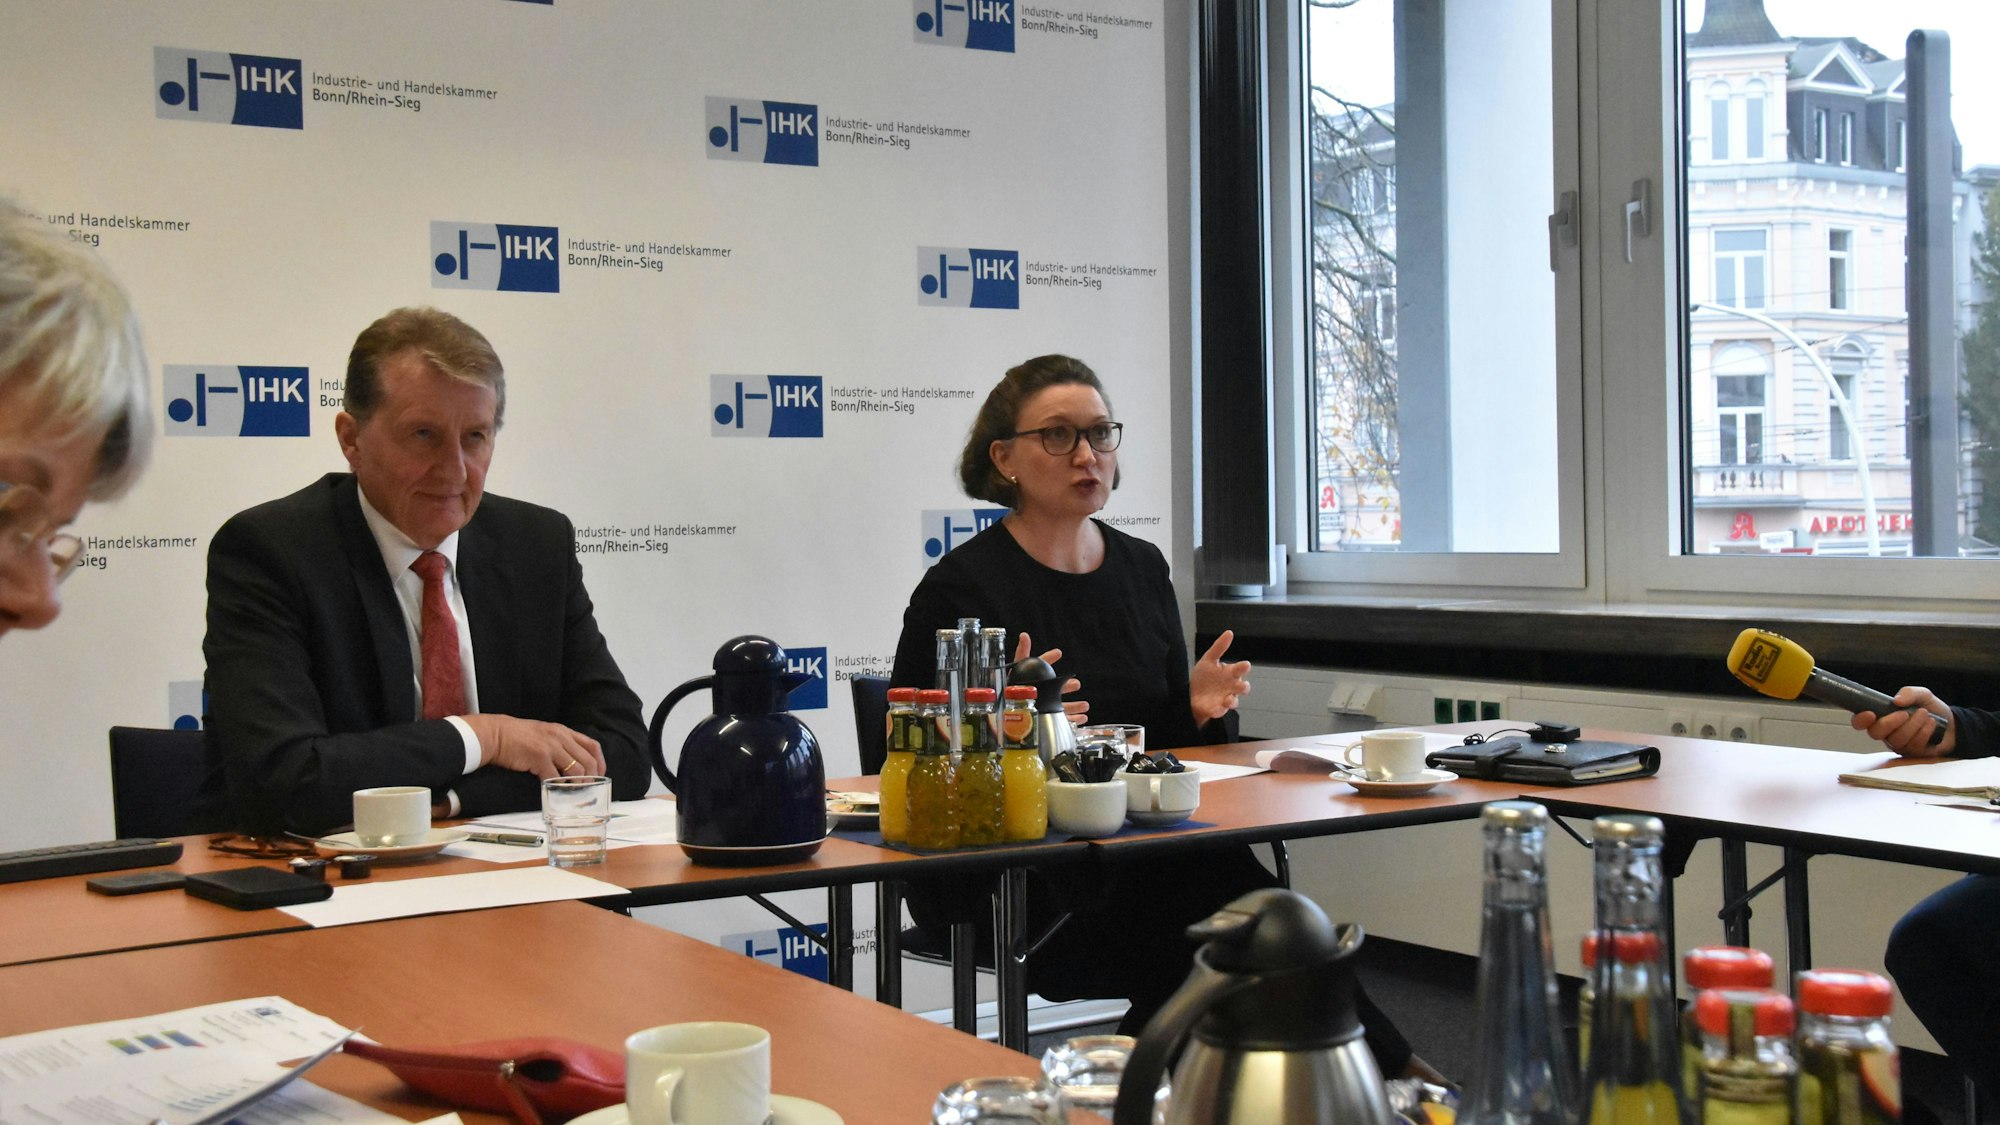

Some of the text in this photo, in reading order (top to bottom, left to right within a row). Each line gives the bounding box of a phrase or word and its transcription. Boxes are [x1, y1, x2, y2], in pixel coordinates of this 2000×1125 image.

[971, 0, 1011, 24] IHK
[1021, 5, 1153, 29] Industrie- und Handelskammer
[1021, 18, 1099, 39] Bonn/Rhein-Sieg
[240, 65, 297, 95] IHK
[312, 72, 499, 100] Industrie- und Handelskammer
[312, 88, 421, 112] Bonn/Rhein-Sieg
[770, 111, 814, 137] IHK
[826, 116, 971, 138] Industrie- und Handelskammer
[826, 130, 911, 150] Bonn/Rhein-Sieg
[48, 212, 75, 226] und
[80, 212, 190, 232] Handelskammer
[505, 235, 554, 262] IHK
[567, 238, 732, 259] Industrie- und Handelskammer
[567, 253, 663, 272] Bonn/Rhein-Sieg
[975, 257, 1015, 281] IHK
[1026, 261, 1157, 277] Industrie- und Handelskammer
[1026, 274, 1102, 290] Bonn/Rhein-Sieg
[248, 377, 304, 403] IHK
[775, 385, 819, 408] IHK
[830, 386, 975, 399] Industrie- und Handelskammer
[830, 400, 915, 415] Bonn/Rhein-Sieg
[630, 525, 650, 537] und
[654, 524, 737, 536] Handelskammer
[1809, 513, 1914, 534] APOTHEK
[88, 536, 197, 549] Handelskammer
[783, 656, 824, 679] HK
[834, 654, 882, 667] Industrie-
